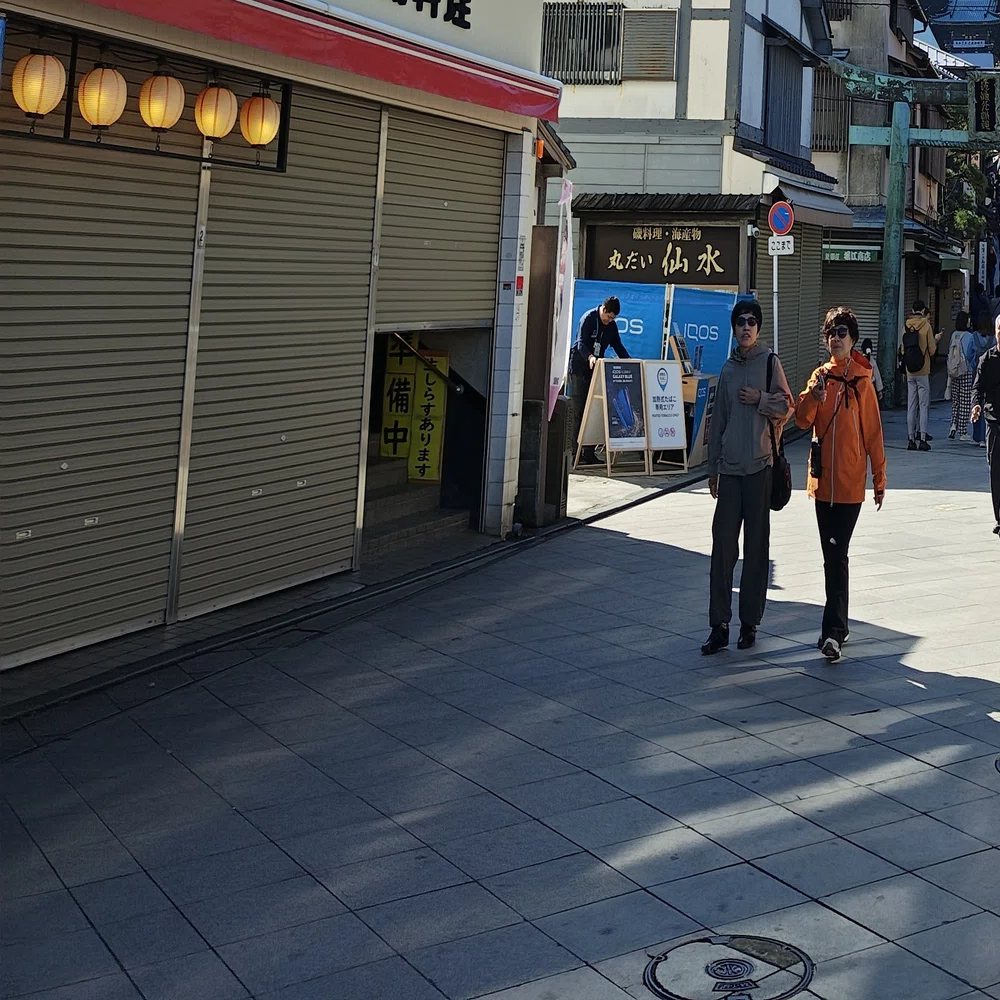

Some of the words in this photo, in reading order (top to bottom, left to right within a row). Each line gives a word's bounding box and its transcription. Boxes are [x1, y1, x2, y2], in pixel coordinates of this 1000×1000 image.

[632, 227, 702, 242] 磯料理・海産物
[771, 240, 792, 251] ここまで
[607, 249, 653, 270] 丸だい
[661, 241, 725, 277] 仙水
[683, 323, 719, 342] IQOS
